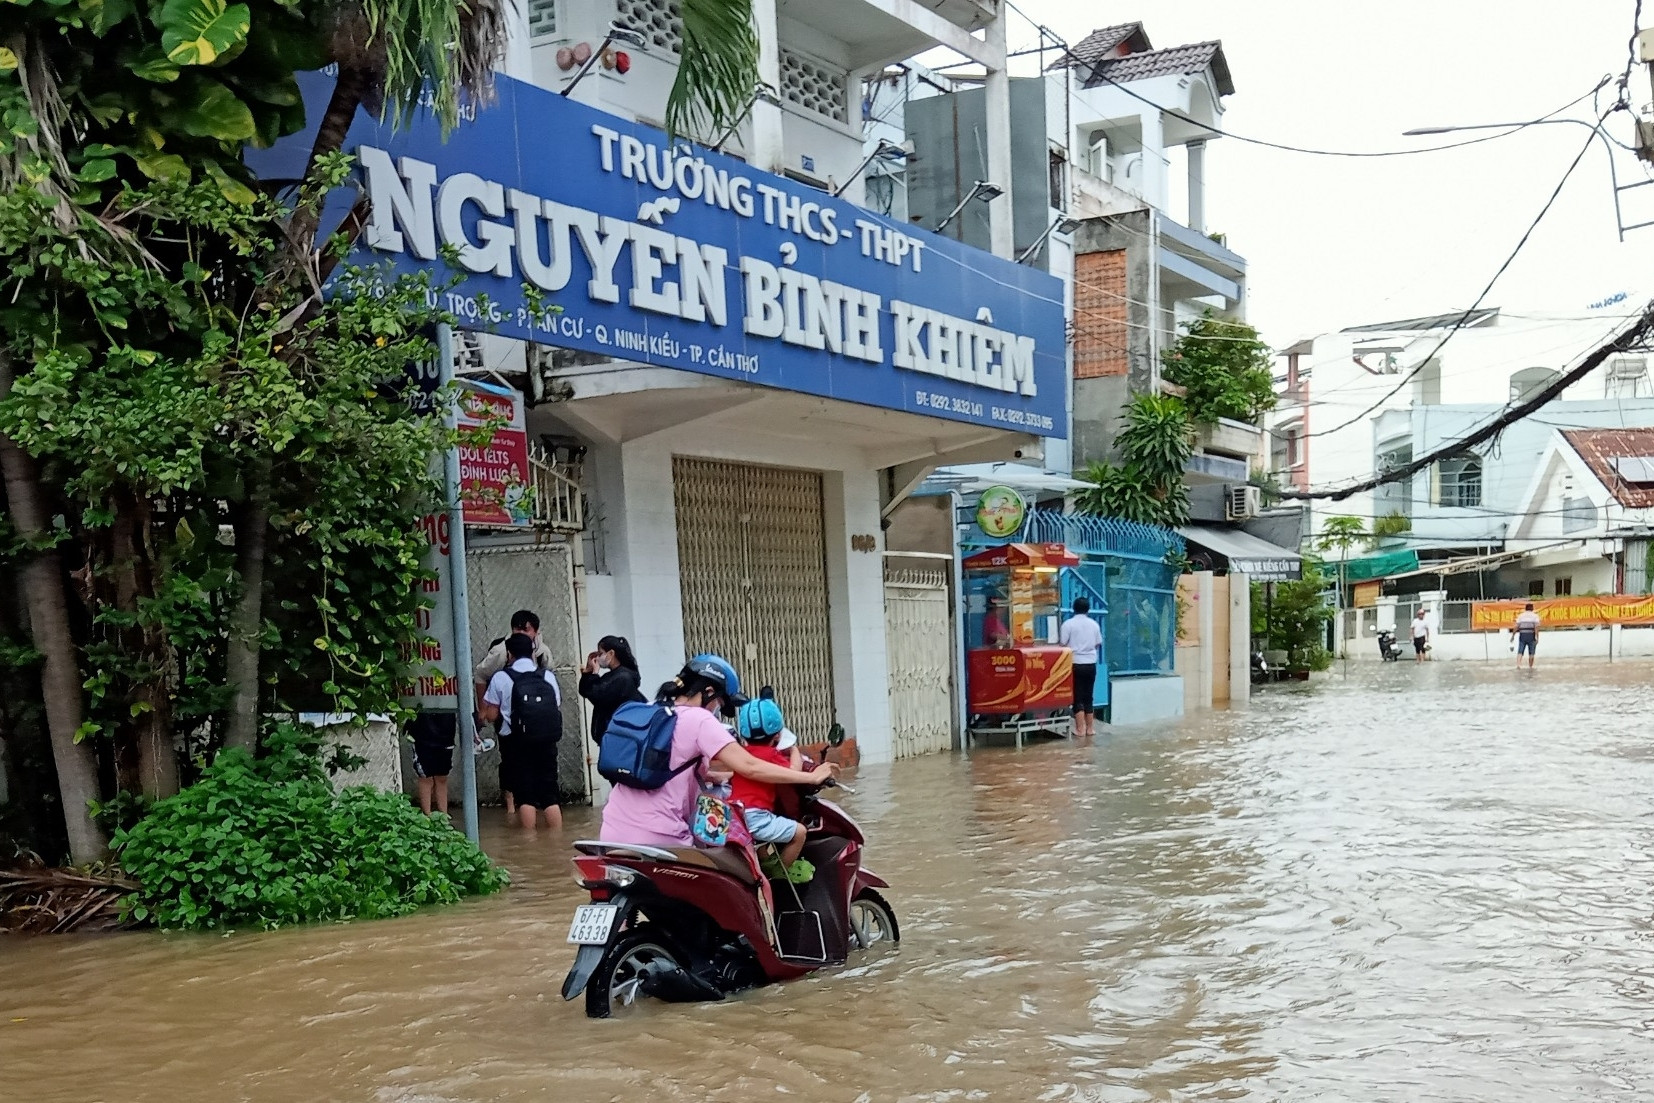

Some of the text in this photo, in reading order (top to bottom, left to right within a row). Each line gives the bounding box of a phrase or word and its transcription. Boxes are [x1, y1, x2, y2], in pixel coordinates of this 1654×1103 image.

[360, 145, 1037, 397] NGUYỄN BỈNH KHIÊM
[591, 124, 754, 217] TRƯỜNG
[757, 183, 838, 245] THCS
[855, 219, 925, 272] THPT
[595, 324, 613, 346] Q.
[614, 328, 647, 353] NINH
[689, 345, 706, 365] TP.
[736, 354, 759, 374] THƠ
